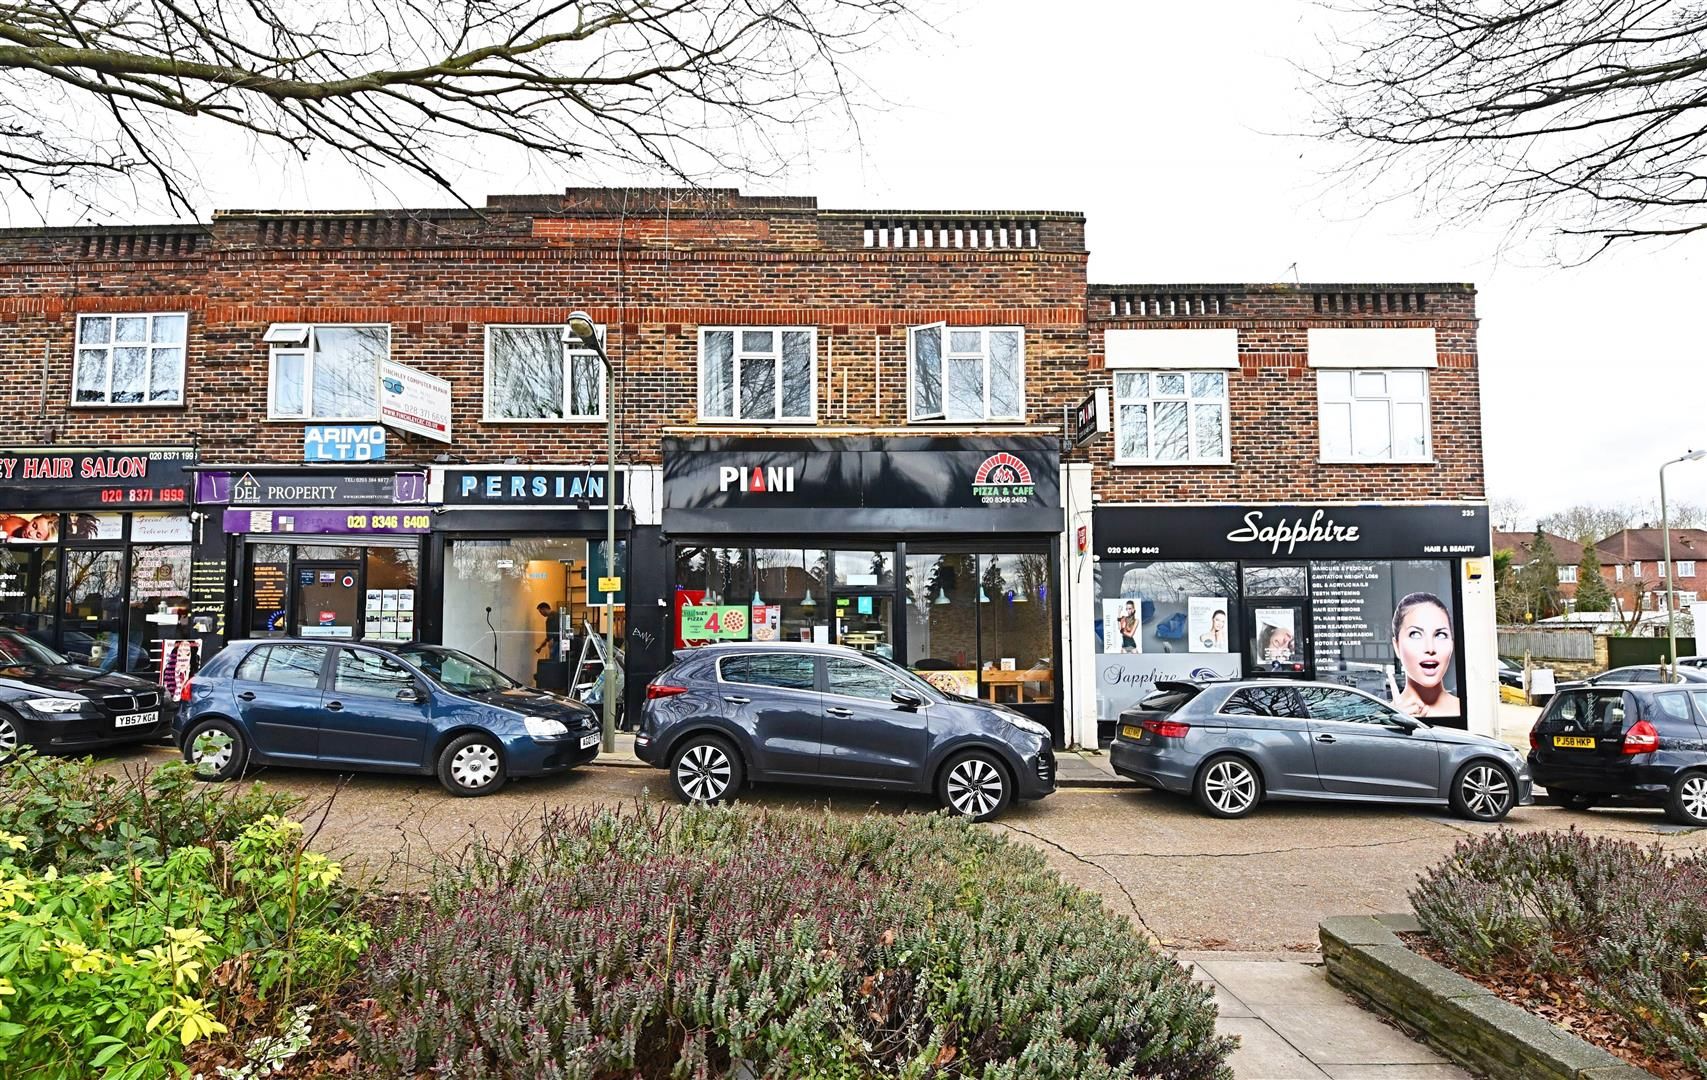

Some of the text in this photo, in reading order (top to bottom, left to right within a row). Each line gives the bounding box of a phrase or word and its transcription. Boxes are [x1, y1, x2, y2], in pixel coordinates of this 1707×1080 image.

[383, 367, 448, 395] FINCHLEY COMPUTER REPAIR
[306, 427, 386, 445] ARIMO
[149, 452, 162, 460] 020
[163, 452, 180, 460] 8371
[317, 444, 372, 460] LTD
[23, 458, 74, 478] HAIR
[81, 457, 147, 477] SALON
[719, 466, 794, 492] PIANI
[234, 486, 337, 499] DEL PROPERTY
[461, 475, 604, 498] PERSIAN
[973, 487, 1034, 496] PIZZA & CAFE
[101, 489, 184, 502] 020 8371 1999
[347, 515, 430, 528] 020 8346 6400
[1226, 509, 1360, 555] Sapphire
[1424, 545, 1475, 553] HAIR & BEAUTY
[1103, 663, 1177, 687] Sapphire
[120, 713, 156, 726] YB57 KGA
[1556, 737, 1575, 746] PJ58
[1576, 738, 1592, 747] HKP
